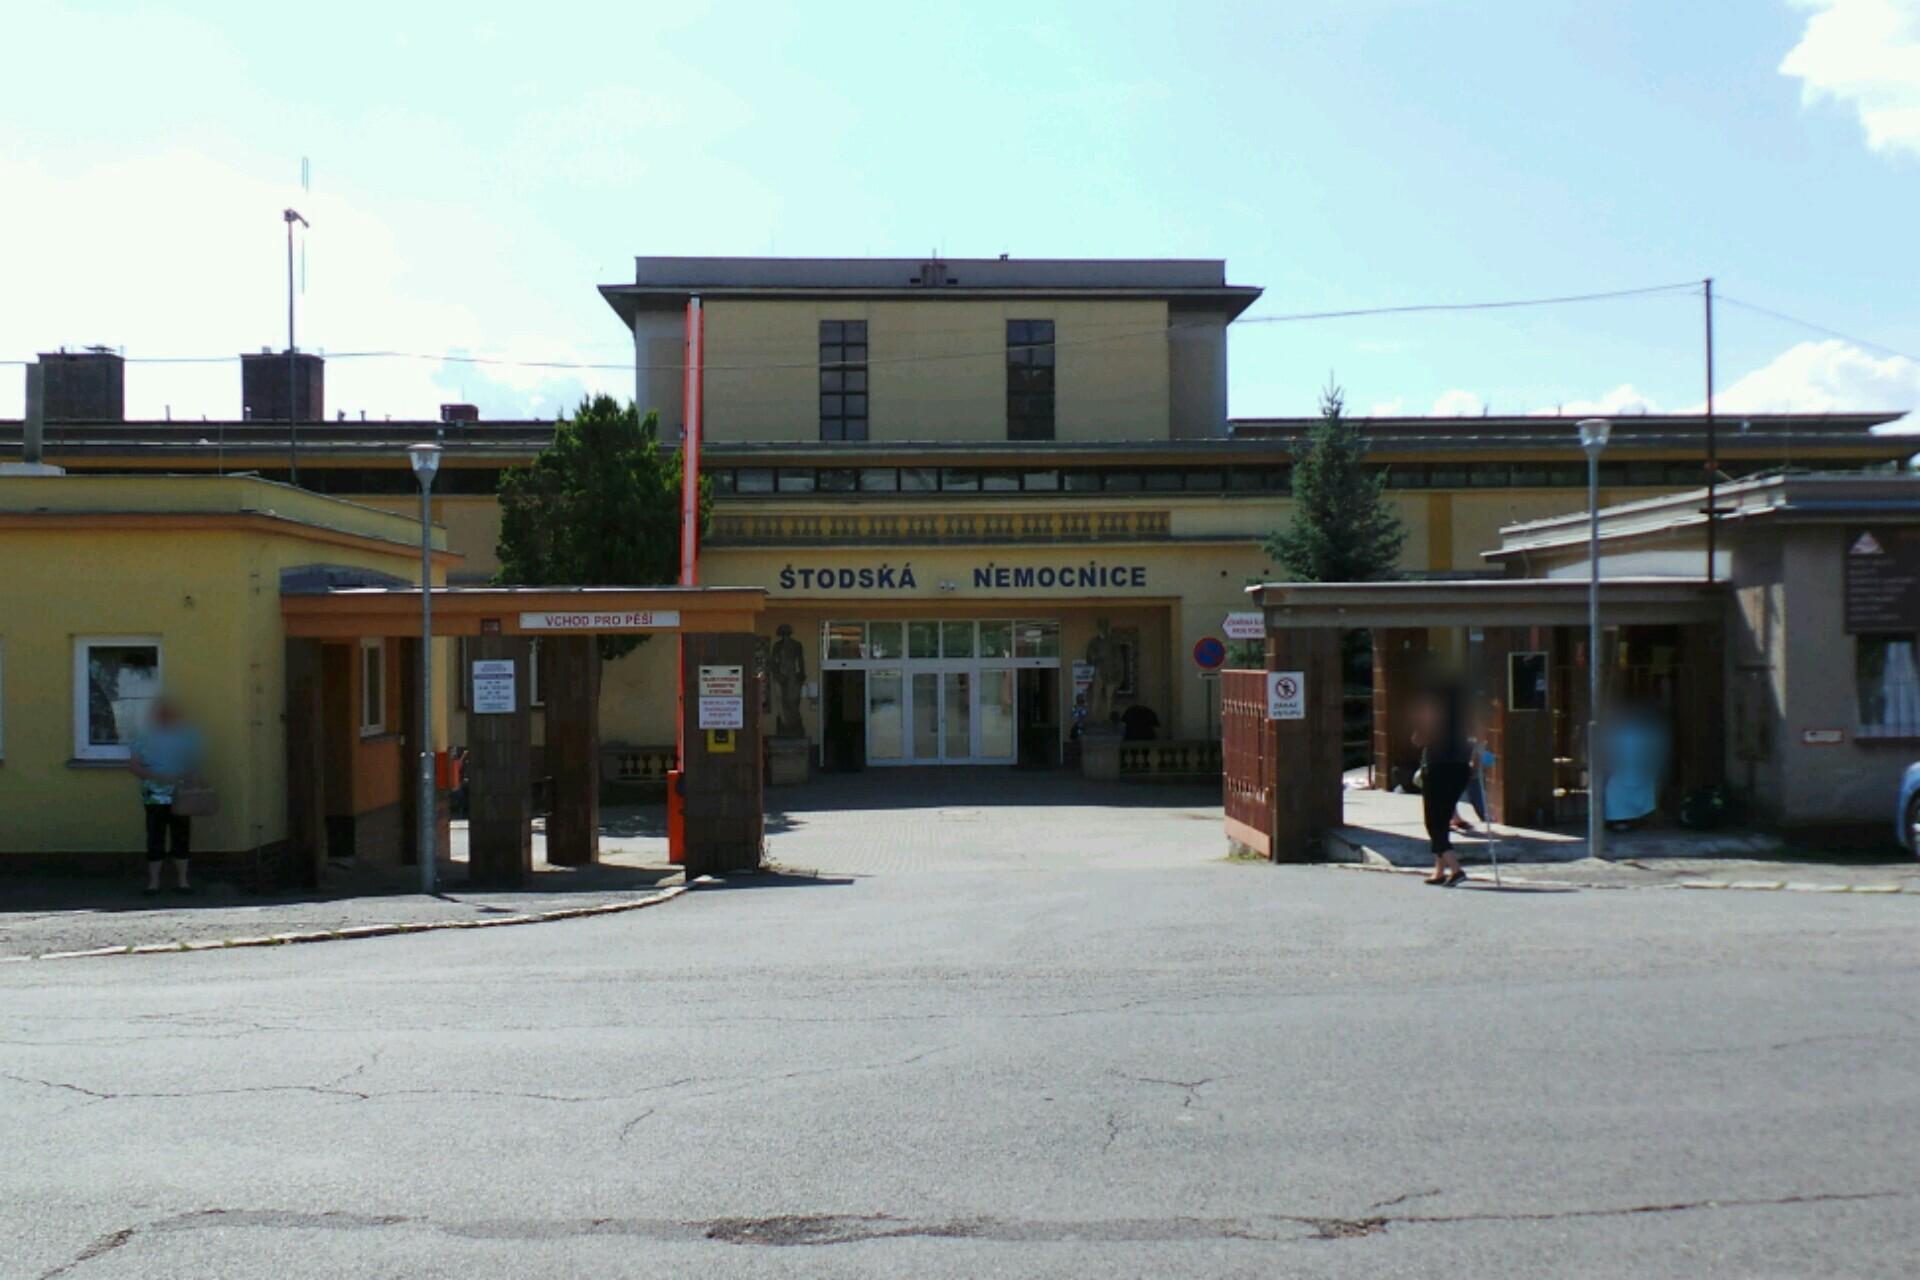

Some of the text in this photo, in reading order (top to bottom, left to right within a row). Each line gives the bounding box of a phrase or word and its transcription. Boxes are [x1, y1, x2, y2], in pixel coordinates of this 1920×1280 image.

[973, 566, 1147, 588] NEMOCNICE
[544, 612, 653, 626] VCHOD PRO PĚŠÍ
